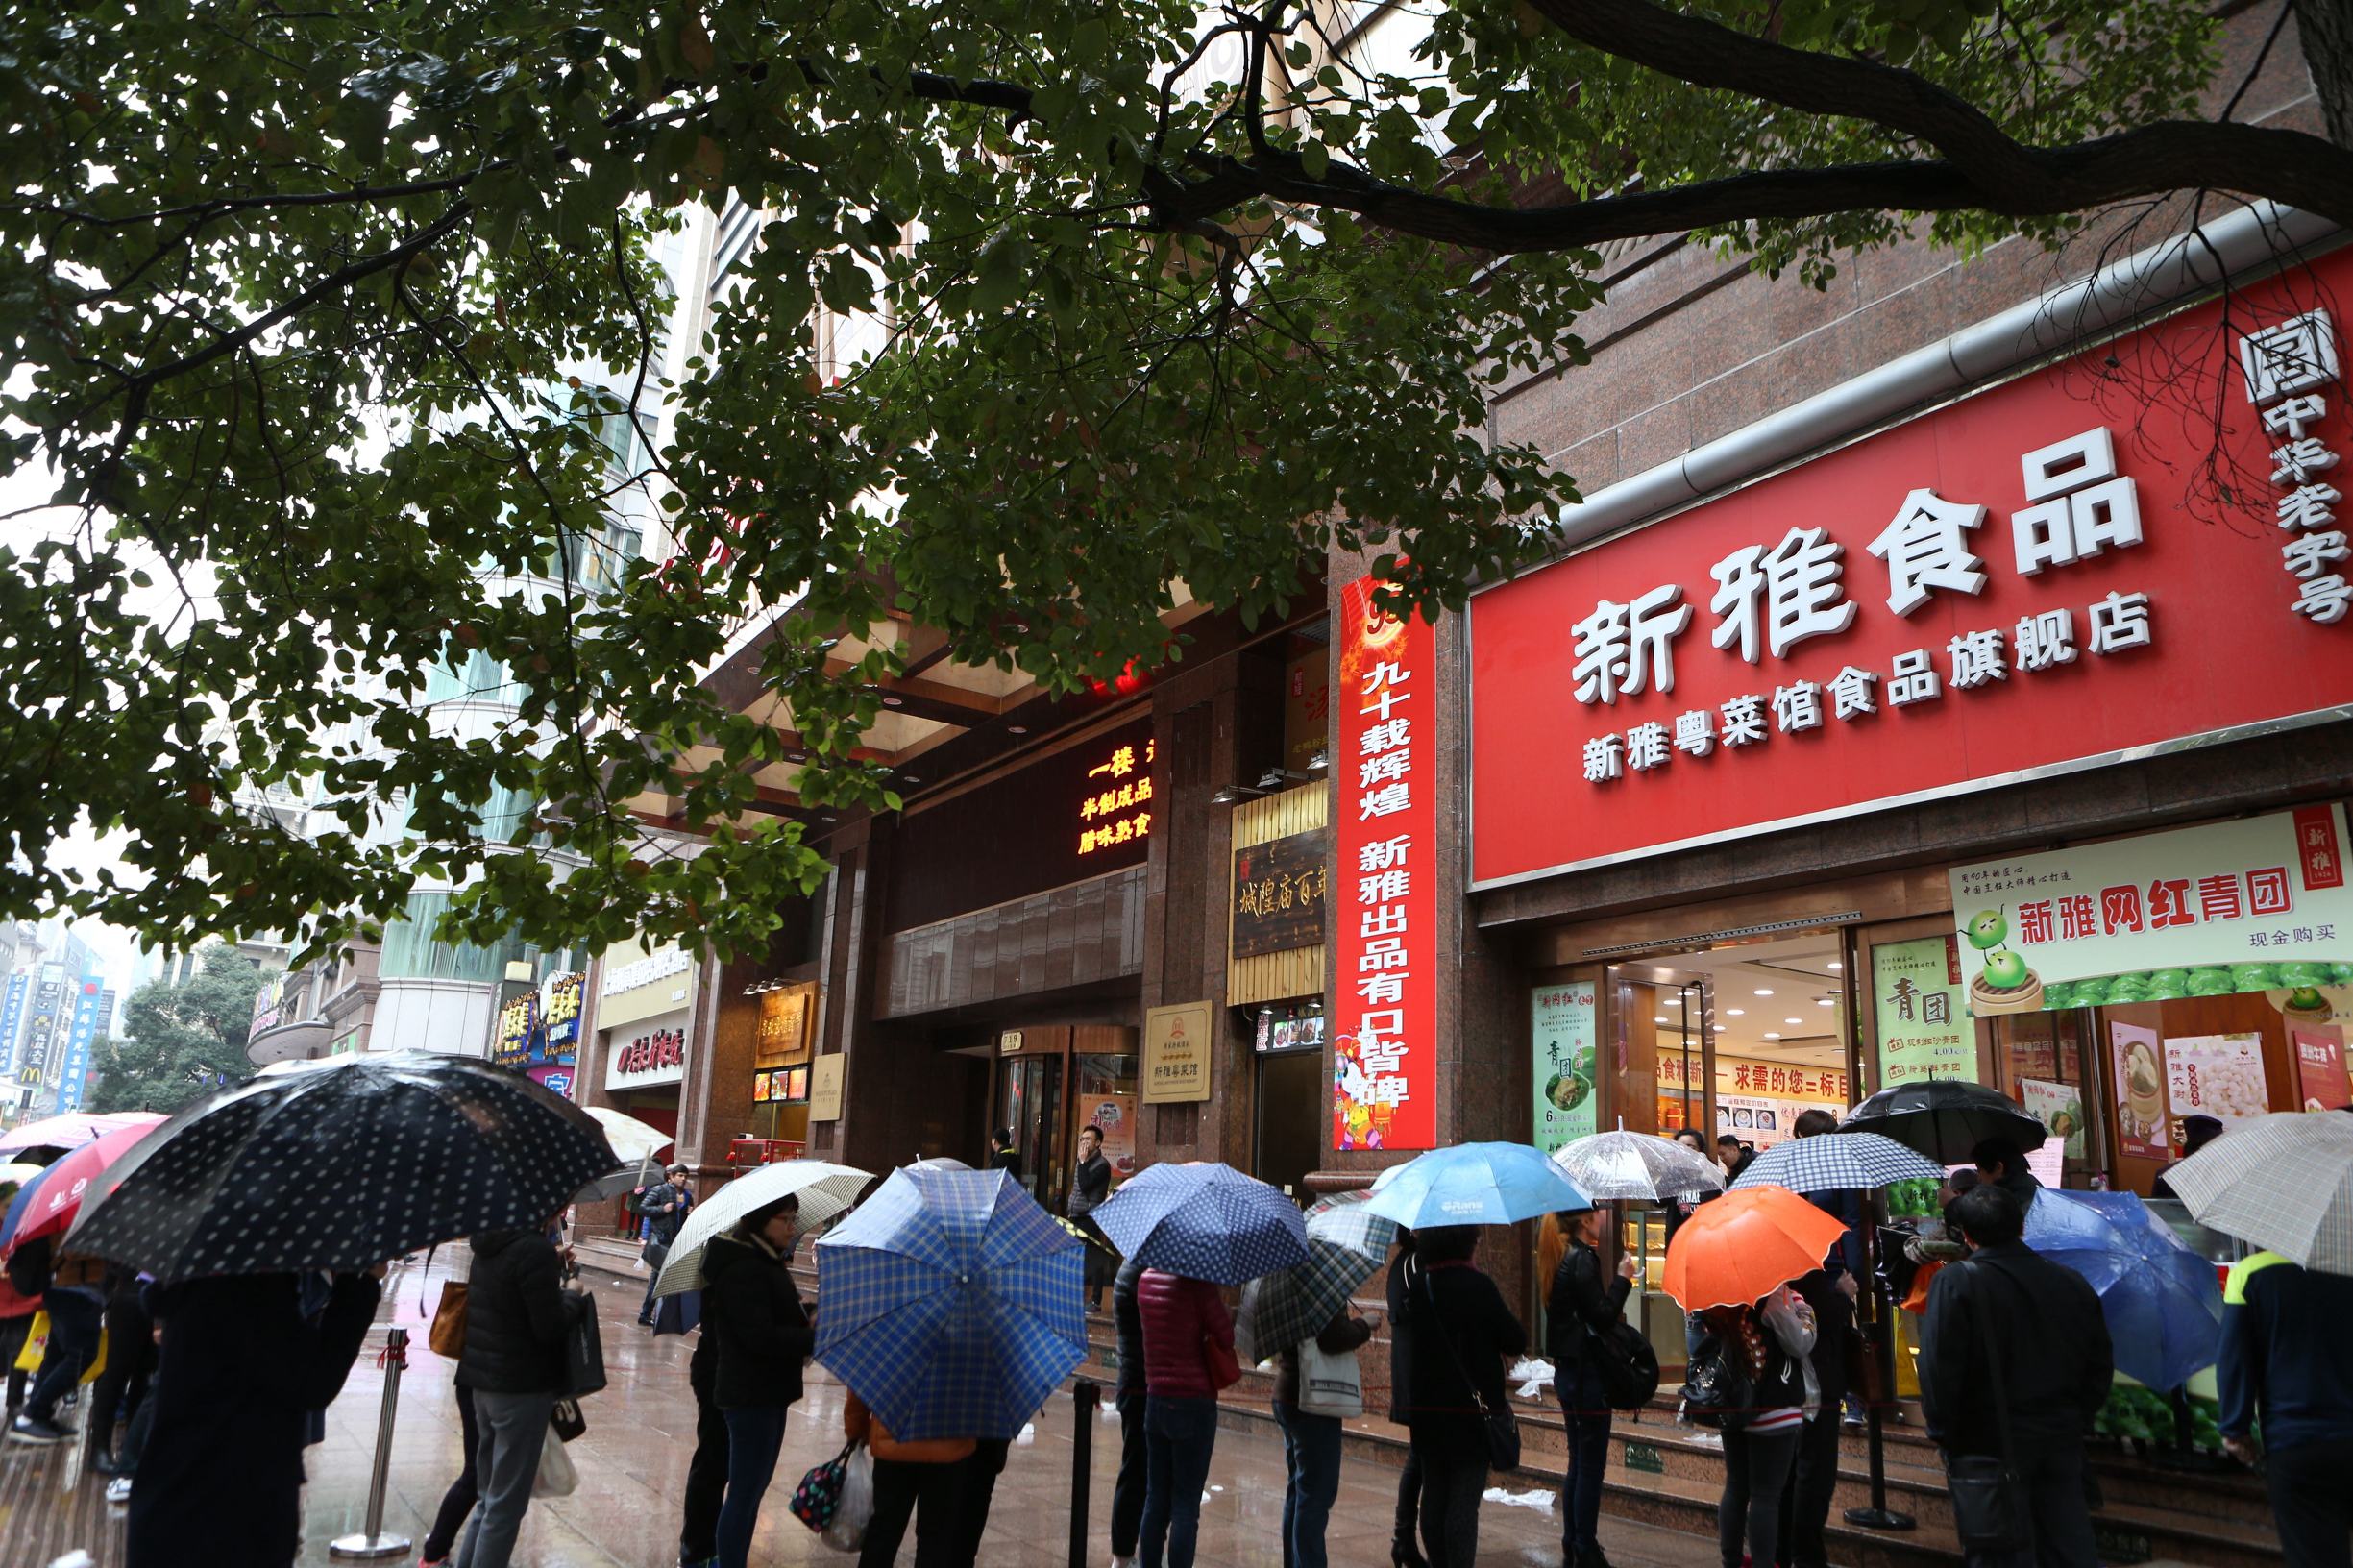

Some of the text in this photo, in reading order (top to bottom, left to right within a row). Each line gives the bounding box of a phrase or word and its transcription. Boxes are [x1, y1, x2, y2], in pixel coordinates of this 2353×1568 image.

[1572, 425, 2144, 705] 新雅食品
[1582, 591, 2153, 783] 新雅粤菜馆食品旗舰店
[1089, 746, 1135, 778] 一楼
[1359, 660, 1411, 821] 九十载辉煌
[1080, 776, 1152, 821] 半制成品
[1078, 813, 1151, 854] 腊味熟食
[2018, 866, 2294, 946] 新雅网红青团
[2249, 924, 2337, 948] 现金购买
[1356, 834, 1412, 1108] 新雅出品有口皆碑
[1886, 976, 1953, 1025] 青团
[2169, 1048, 2186, 1100] 新雅大厨
